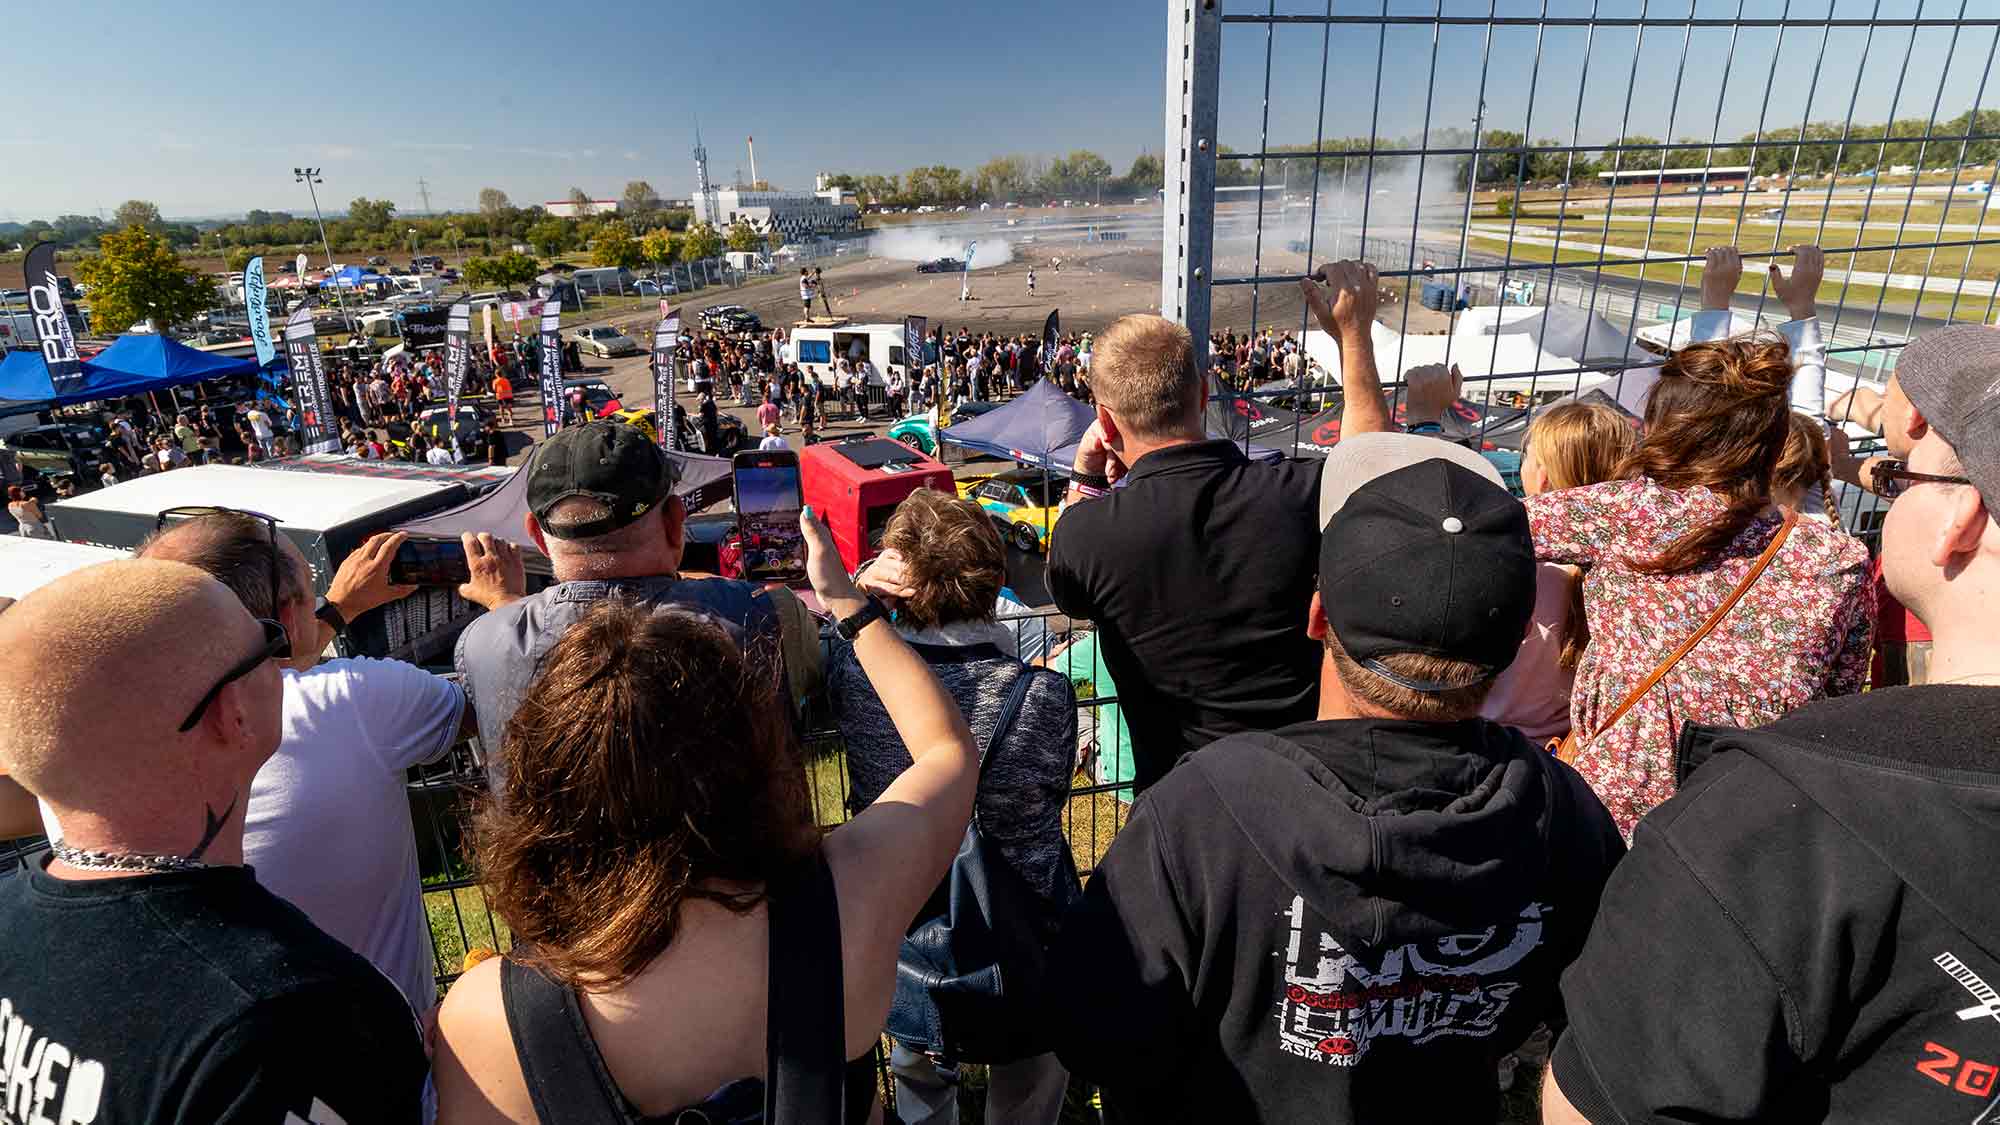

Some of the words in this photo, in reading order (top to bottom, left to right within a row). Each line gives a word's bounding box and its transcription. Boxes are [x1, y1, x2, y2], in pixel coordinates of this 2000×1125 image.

[30, 285, 68, 363] PRO
[1280, 1040, 1323, 1063] ASIA
[1915, 1041, 1999, 1098] 20
